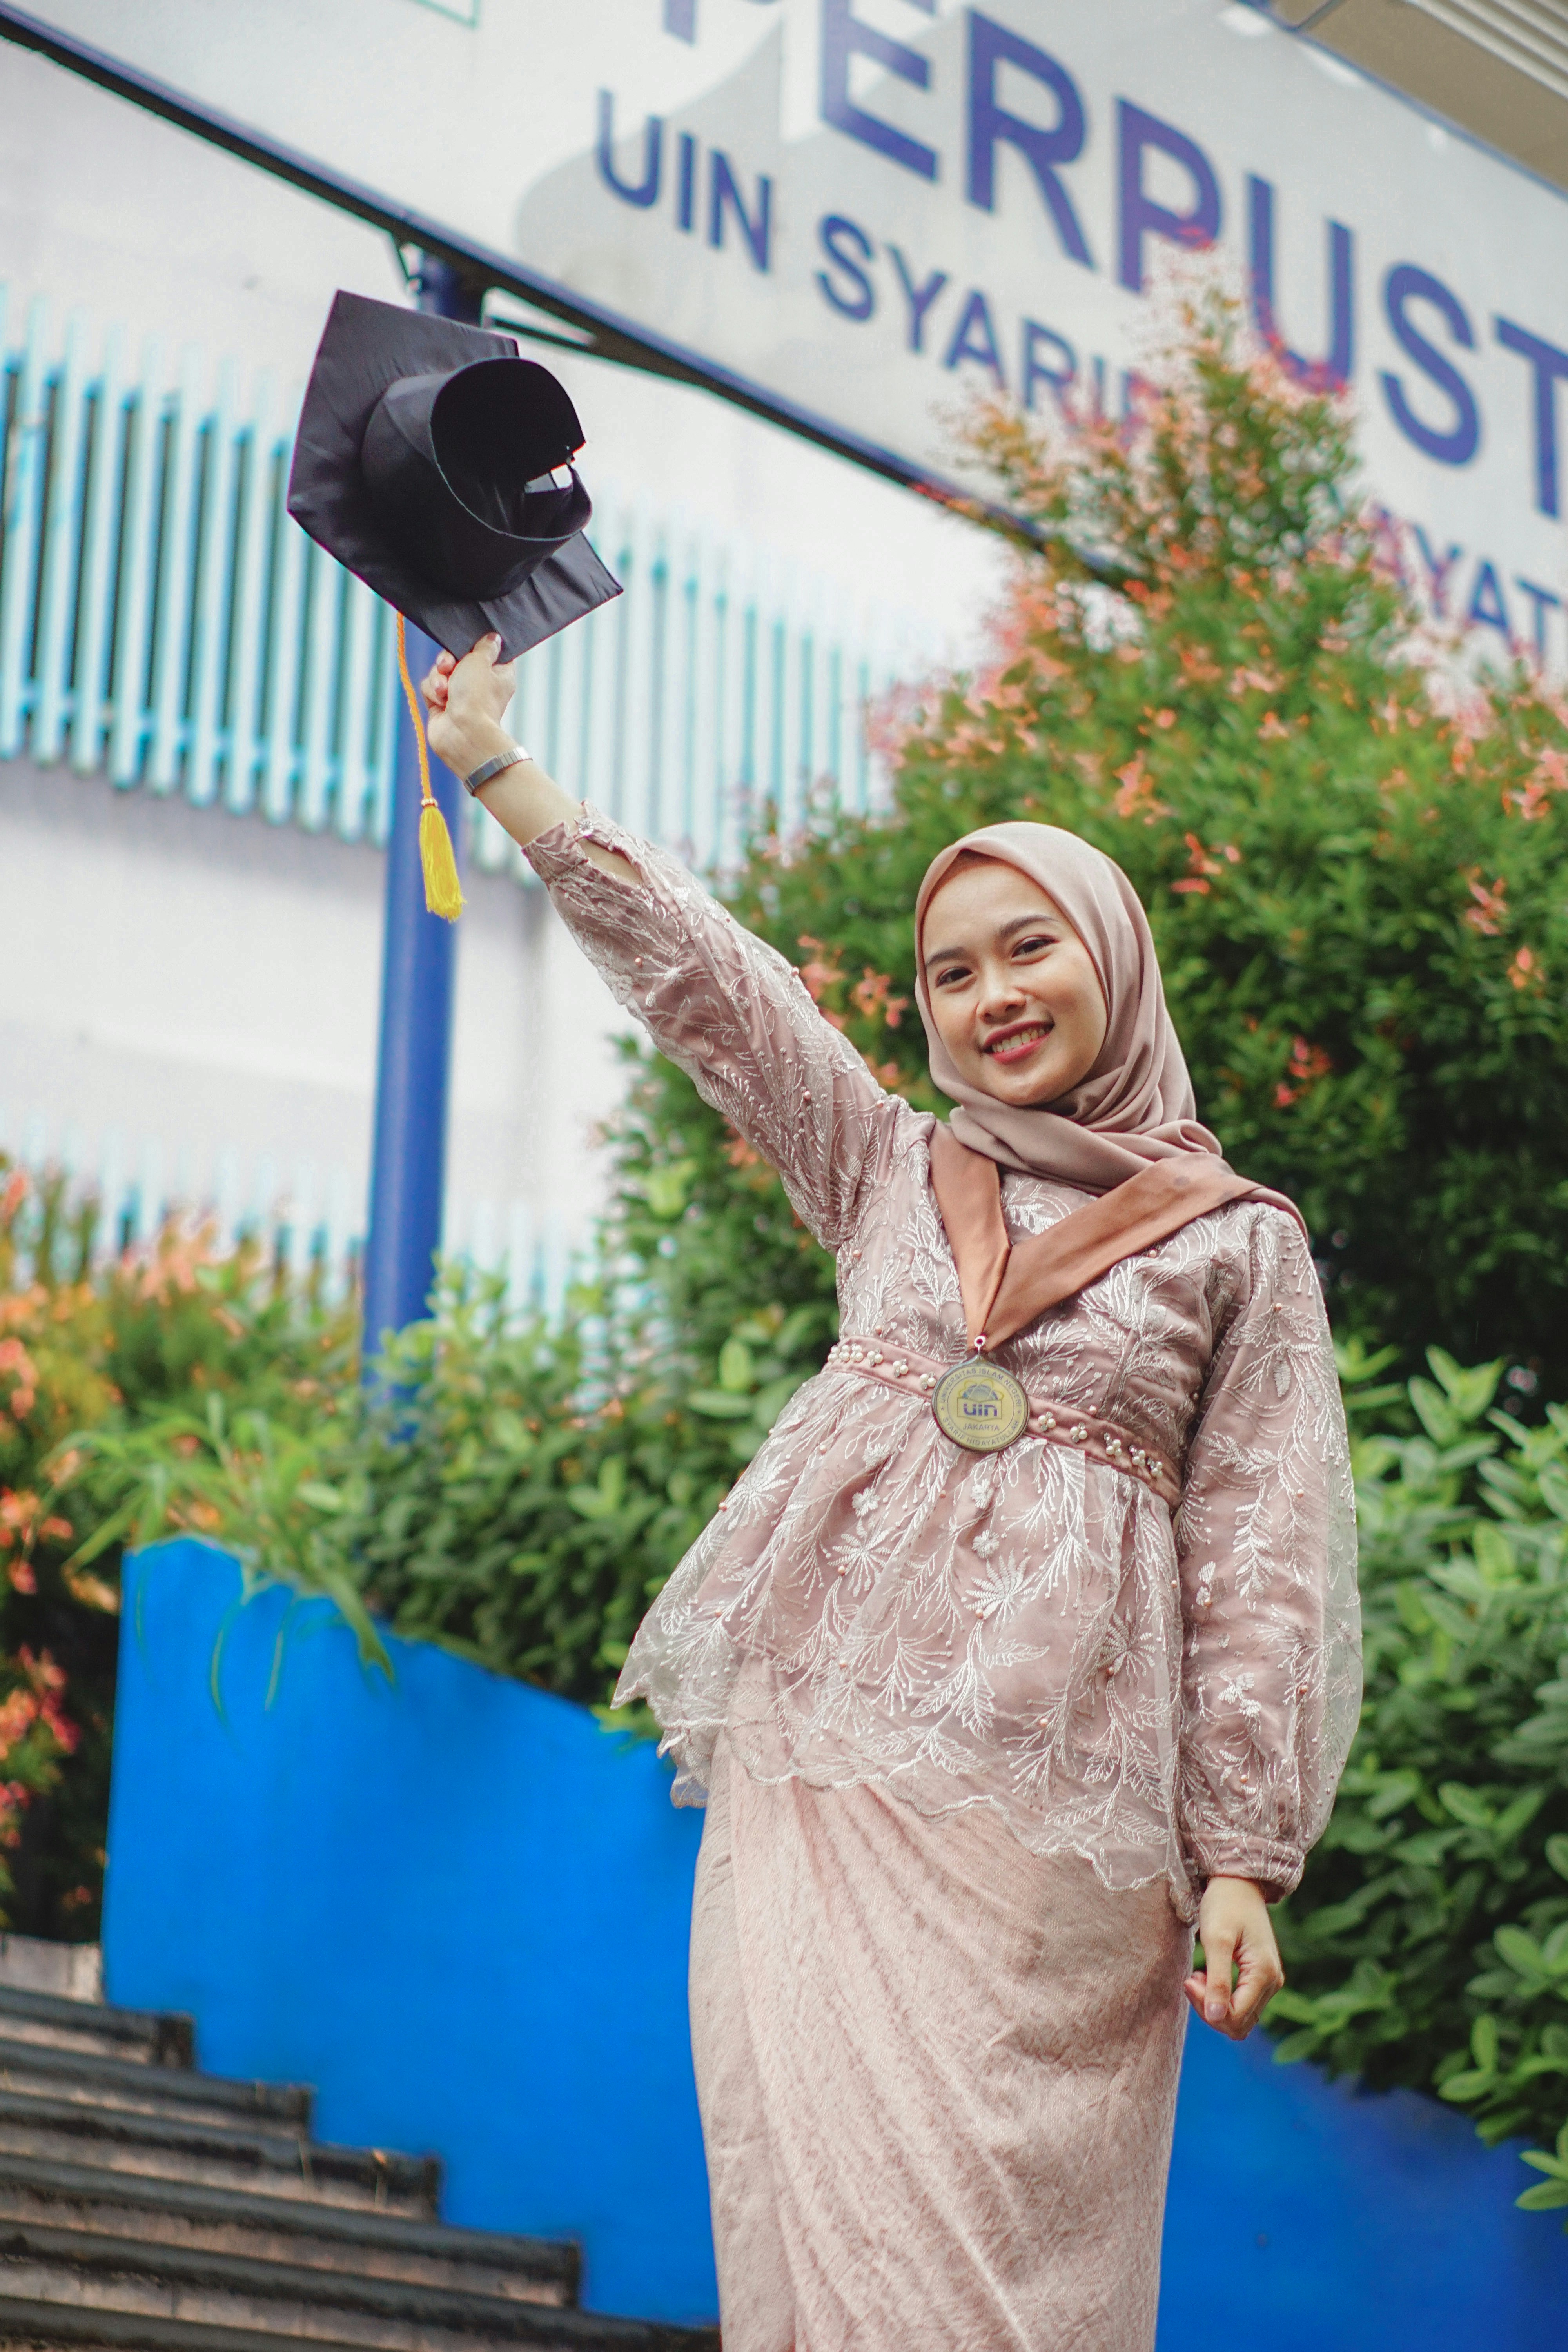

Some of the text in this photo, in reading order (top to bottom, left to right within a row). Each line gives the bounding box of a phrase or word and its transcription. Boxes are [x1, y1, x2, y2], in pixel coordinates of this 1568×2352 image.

[595, 87, 772, 274] UIN
[664, 0, 1568, 519] ERPUST
[940, 1367, 1022, 1407] UNIVERSITAS ISLAM NEGERI
[943, 1417, 1019, 1447] SYARIF HIDAYATULLAH
[963, 1423, 1000, 1432] JAKARTA
